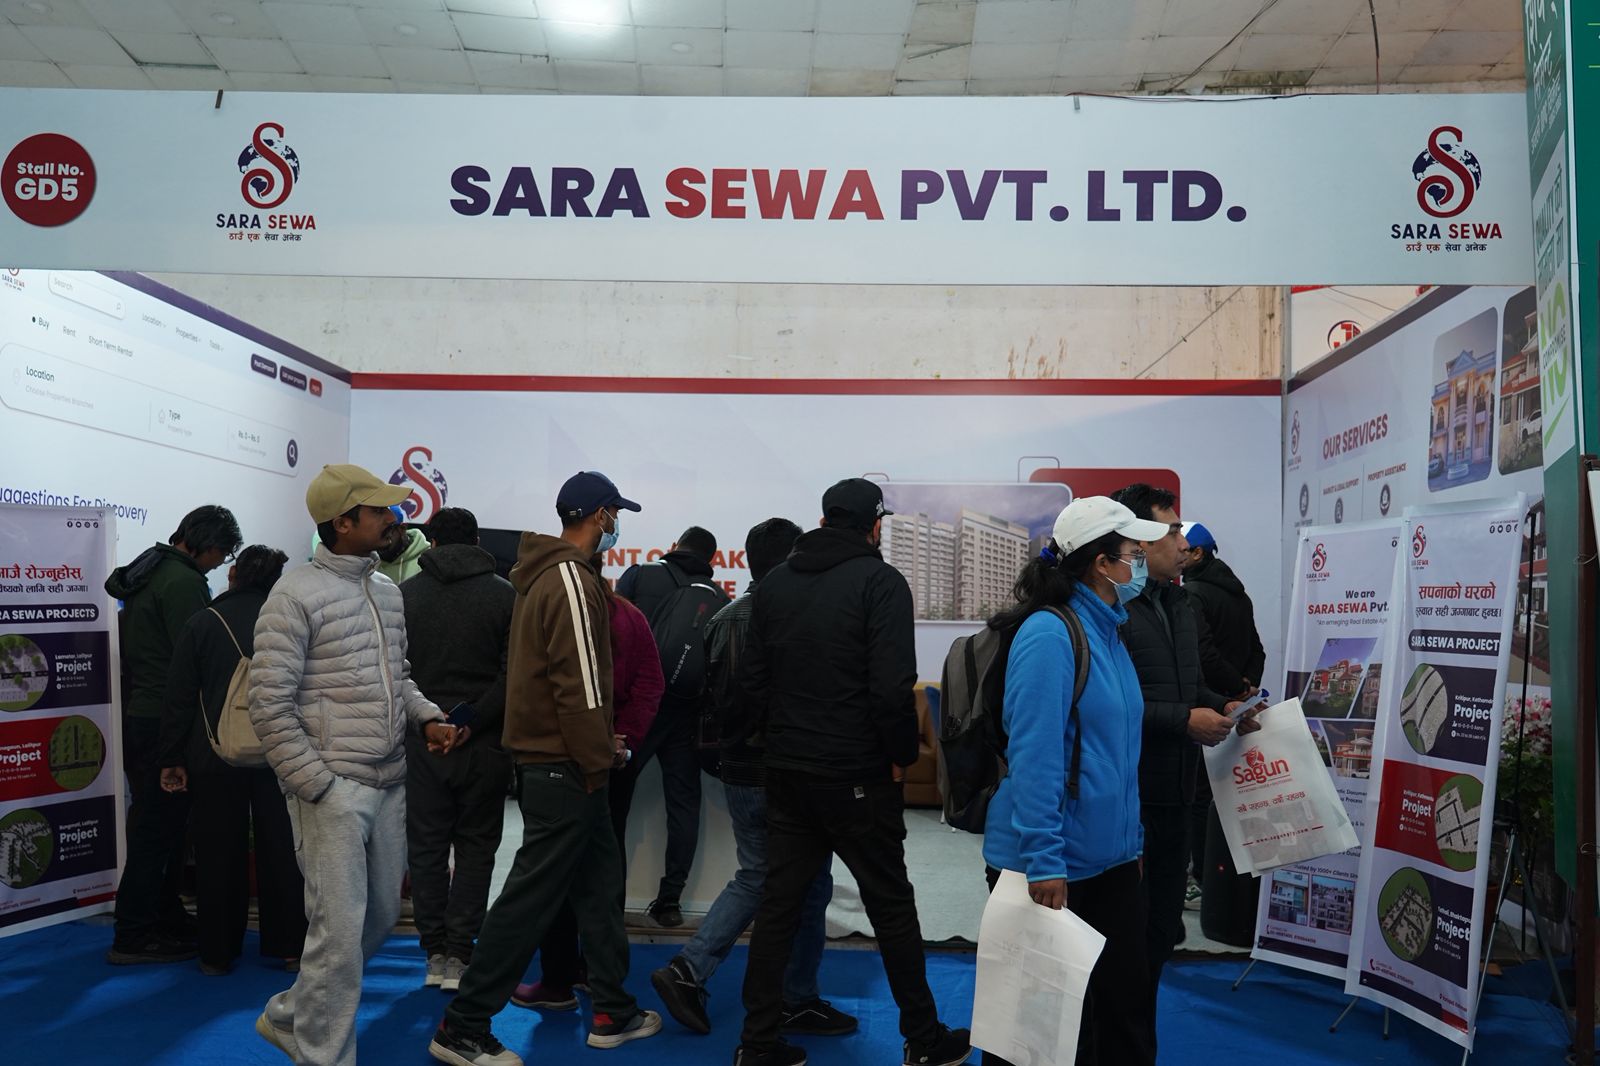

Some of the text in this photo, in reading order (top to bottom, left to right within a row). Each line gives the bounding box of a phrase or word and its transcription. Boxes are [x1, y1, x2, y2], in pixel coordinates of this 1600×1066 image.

[17, 162, 84, 176] Stall No.
[14, 178, 79, 201] GD5
[450, 164, 1248, 222] SARA SEWA PVT. LTD.
[216, 213, 317, 230] SARA SEWA
[229, 231, 302, 242] ठाउँ एक सेवा अनेक
[1391, 223, 1503, 239] SARA SEWA
[1406, 241, 1488, 253] ठाउँ एक सेवा अनेक
[38, 316, 50, 331] Buy
[63, 325, 77, 337] Rent
[88, 335, 103, 348] Short
[104, 340, 117, 353] Term
[26, 365, 55, 383] Location
[168, 409, 181, 422] Type
[1323, 413, 1388, 460] OUR SERVICES
[1368, 462, 1407, 481] PROPERTY ASSISTANCE
[25, 582, 46, 594] लागि
[47, 583, 64, 594] सही
[1345, 590, 1376, 599] We are
[1419, 581, 1497, 600] सपनाको घरको
[12, 610, 45, 620] SEWA
[46, 608, 96, 619] PROJECTS
[1308, 603, 1335, 615] SARA
[1337, 602, 1368, 614] SEWA
[1435, 605, 1449, 616] सही
[1411, 635, 1426, 646] SARA
[1427, 636, 1454, 648] SEWA
[56, 660, 92, 675] Project
[1454, 703, 1493, 723] Projec
[1232, 759, 1289, 785] Sagun
[1402, 799, 1431, 818] Project
[60, 827, 98, 844] Project
[1436, 916, 1471, 941] Project
